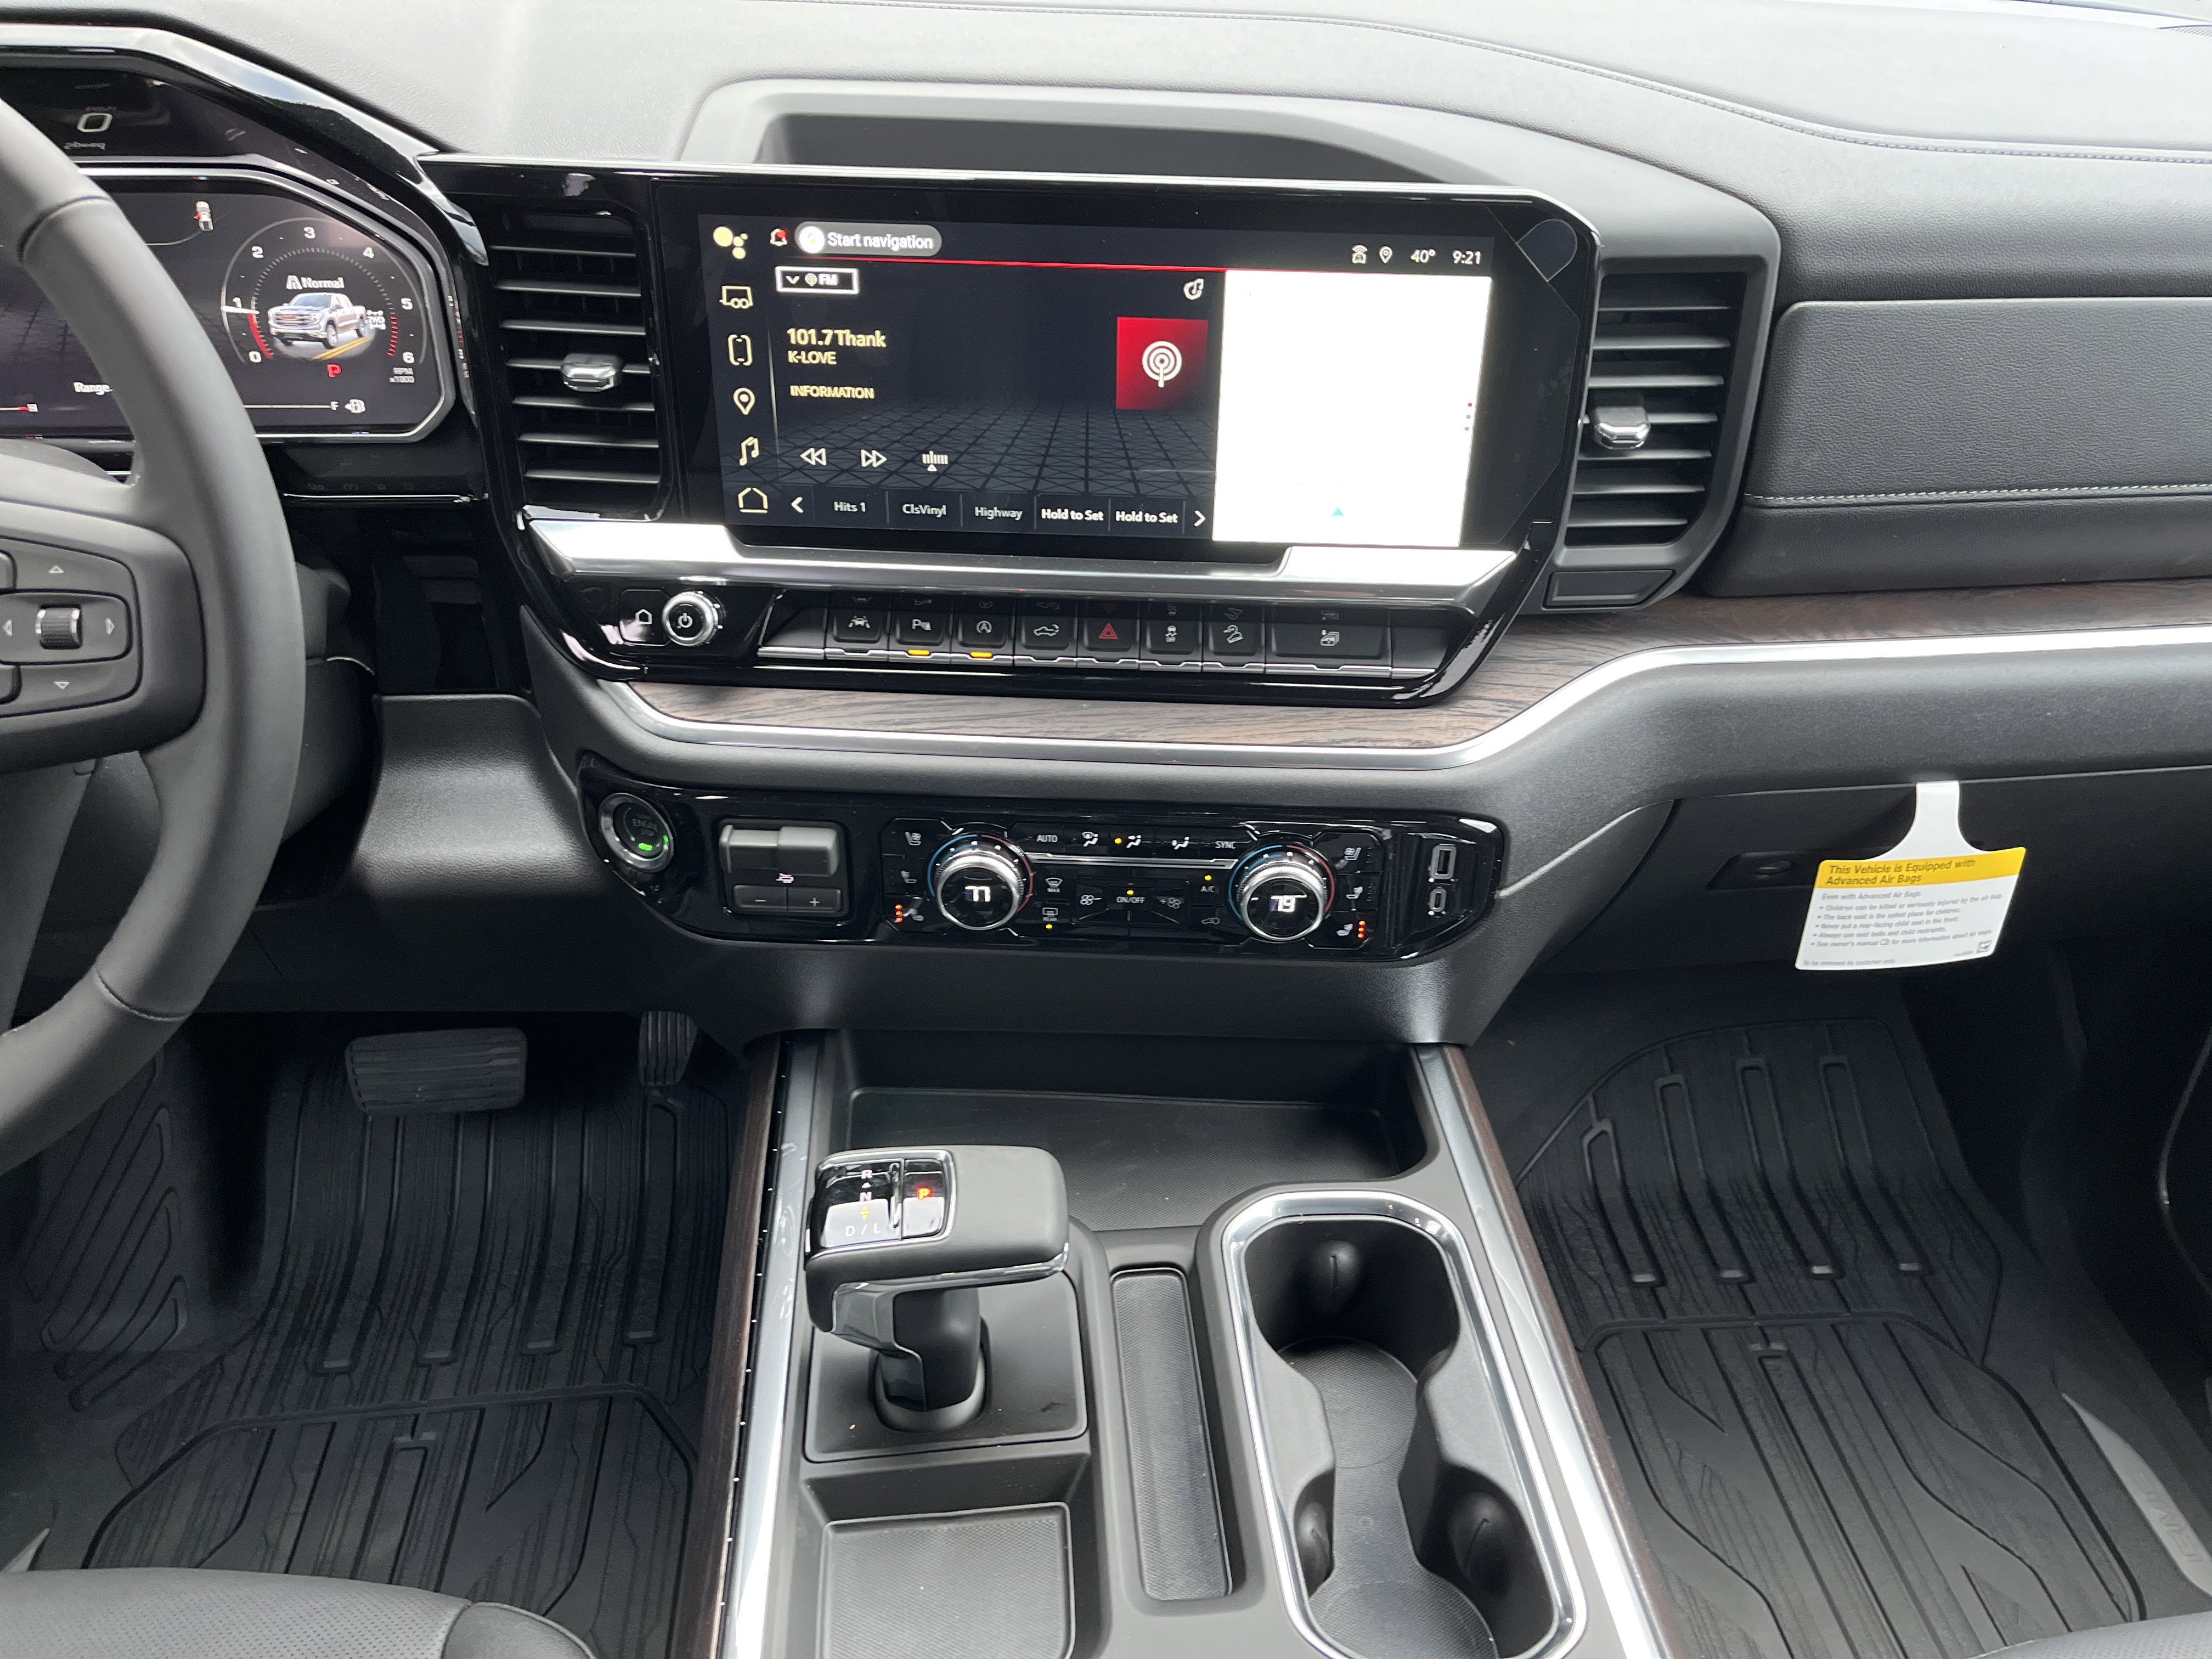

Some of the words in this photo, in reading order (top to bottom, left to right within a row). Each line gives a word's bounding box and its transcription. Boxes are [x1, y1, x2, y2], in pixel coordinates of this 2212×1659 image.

[303, 227, 315, 239] 3
[828, 231, 861, 247] Start
[863, 233, 933, 250] navigation
[251, 246, 264, 258] 2
[363, 247, 374, 258] 4
[1452, 250, 1481, 265] 9:21
[301, 276, 345, 289] Normal
[819, 274, 838, 286] FM
[233, 297, 242, 308] 1
[401, 298, 413, 309] 5
[787, 329, 832, 346] 101.7
[834, 330, 886, 348] Thank
[249, 351, 262, 363] 0
[403, 351, 415, 363] 6
[788, 351, 837, 365] K-LOVE
[328, 364, 342, 377] P
[74, 382, 110, 396] Range
[790, 385, 874, 399] INFORMATION
[833, 500, 858, 512] Hits
[860, 501, 866, 512] 1
[902, 504, 946, 518] ClsVinyl
[975, 506, 1023, 521] Highway
[1041, 508, 1068, 521] Hold
[1070, 510, 1083, 521] to
[1085, 510, 1104, 522] Set
[1115, 511, 1142, 523] Hold
[1144, 513, 1157, 523] to
[1159, 512, 1178, 524] Set
[1036, 834, 1058, 843] AUTO
[1215, 840, 1236, 850] SYNC
[1830, 865, 1850, 874] This
[1854, 864, 1892, 874] Vehicle
[1894, 864, 1903, 872] is
[1905, 861, 1952, 873] Equipped
[1954, 859, 1976, 868] with
[1826, 876, 1877, 885] Advanced
[1880, 876, 1893, 884] Air
[1897, 874, 1923, 885] Bags
[861, 1169, 872, 1179] R
[860, 1192, 872, 1201] N
[917, 1187, 932, 1200] P
[845, 1226, 855, 1237] D
[873, 1223, 881, 1234] L
